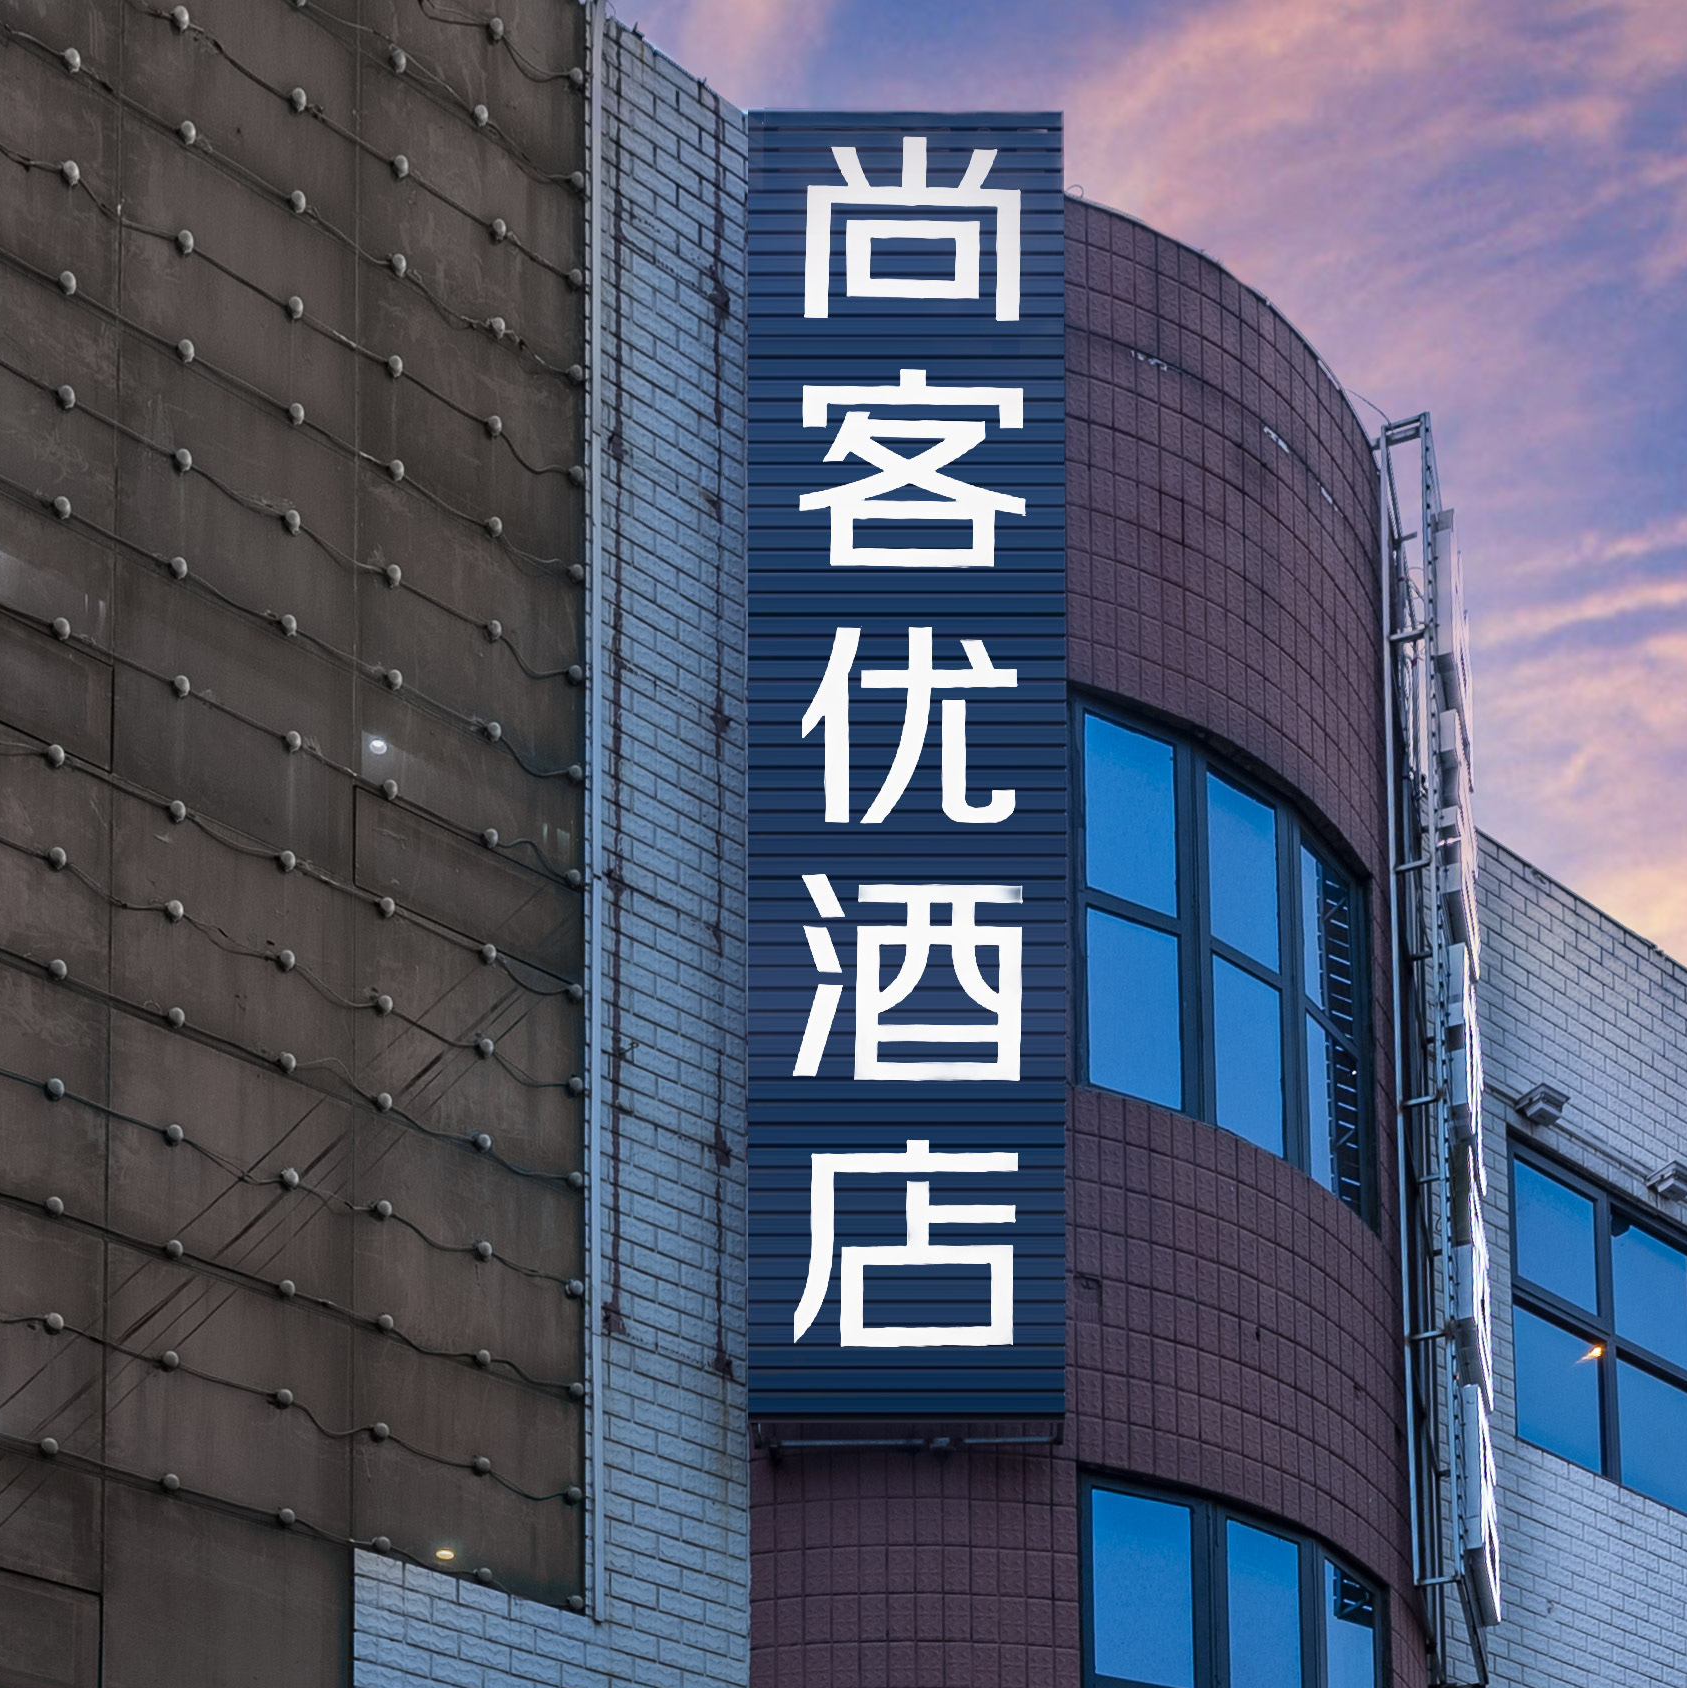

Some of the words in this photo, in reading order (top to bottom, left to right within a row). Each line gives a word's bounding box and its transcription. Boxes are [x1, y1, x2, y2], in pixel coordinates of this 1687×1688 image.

[794, 136, 1027, 1348] 尚客优酒店
